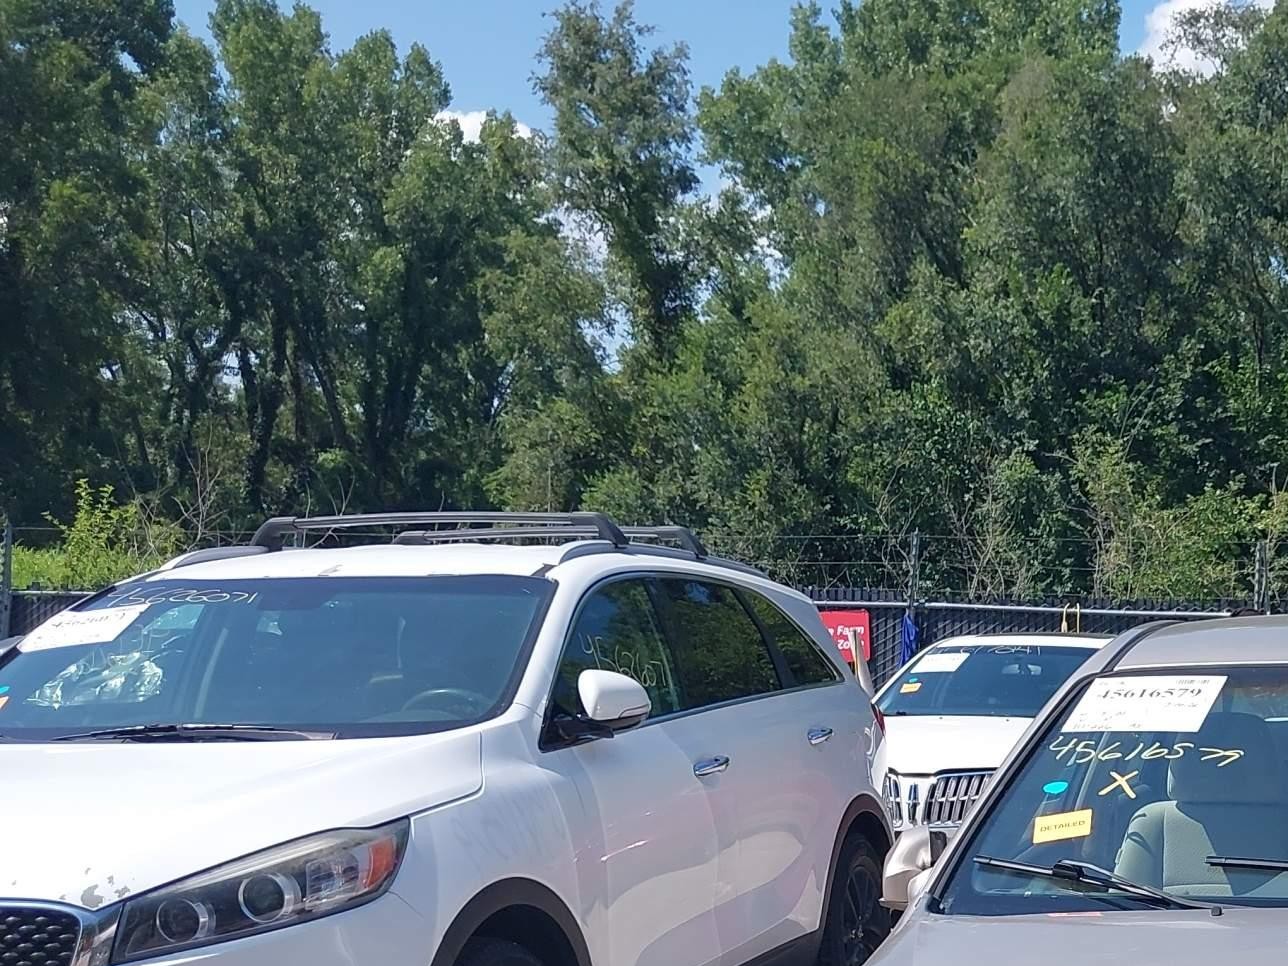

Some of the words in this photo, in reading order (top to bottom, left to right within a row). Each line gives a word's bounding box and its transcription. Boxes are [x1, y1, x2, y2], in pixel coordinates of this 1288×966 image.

[837, 639, 864, 650] Zo
[1097, 687, 1202, 699] 45616579
[1049, 736, 1245, 767] 45616579
[1040, 820, 1086, 832] DETAILED
